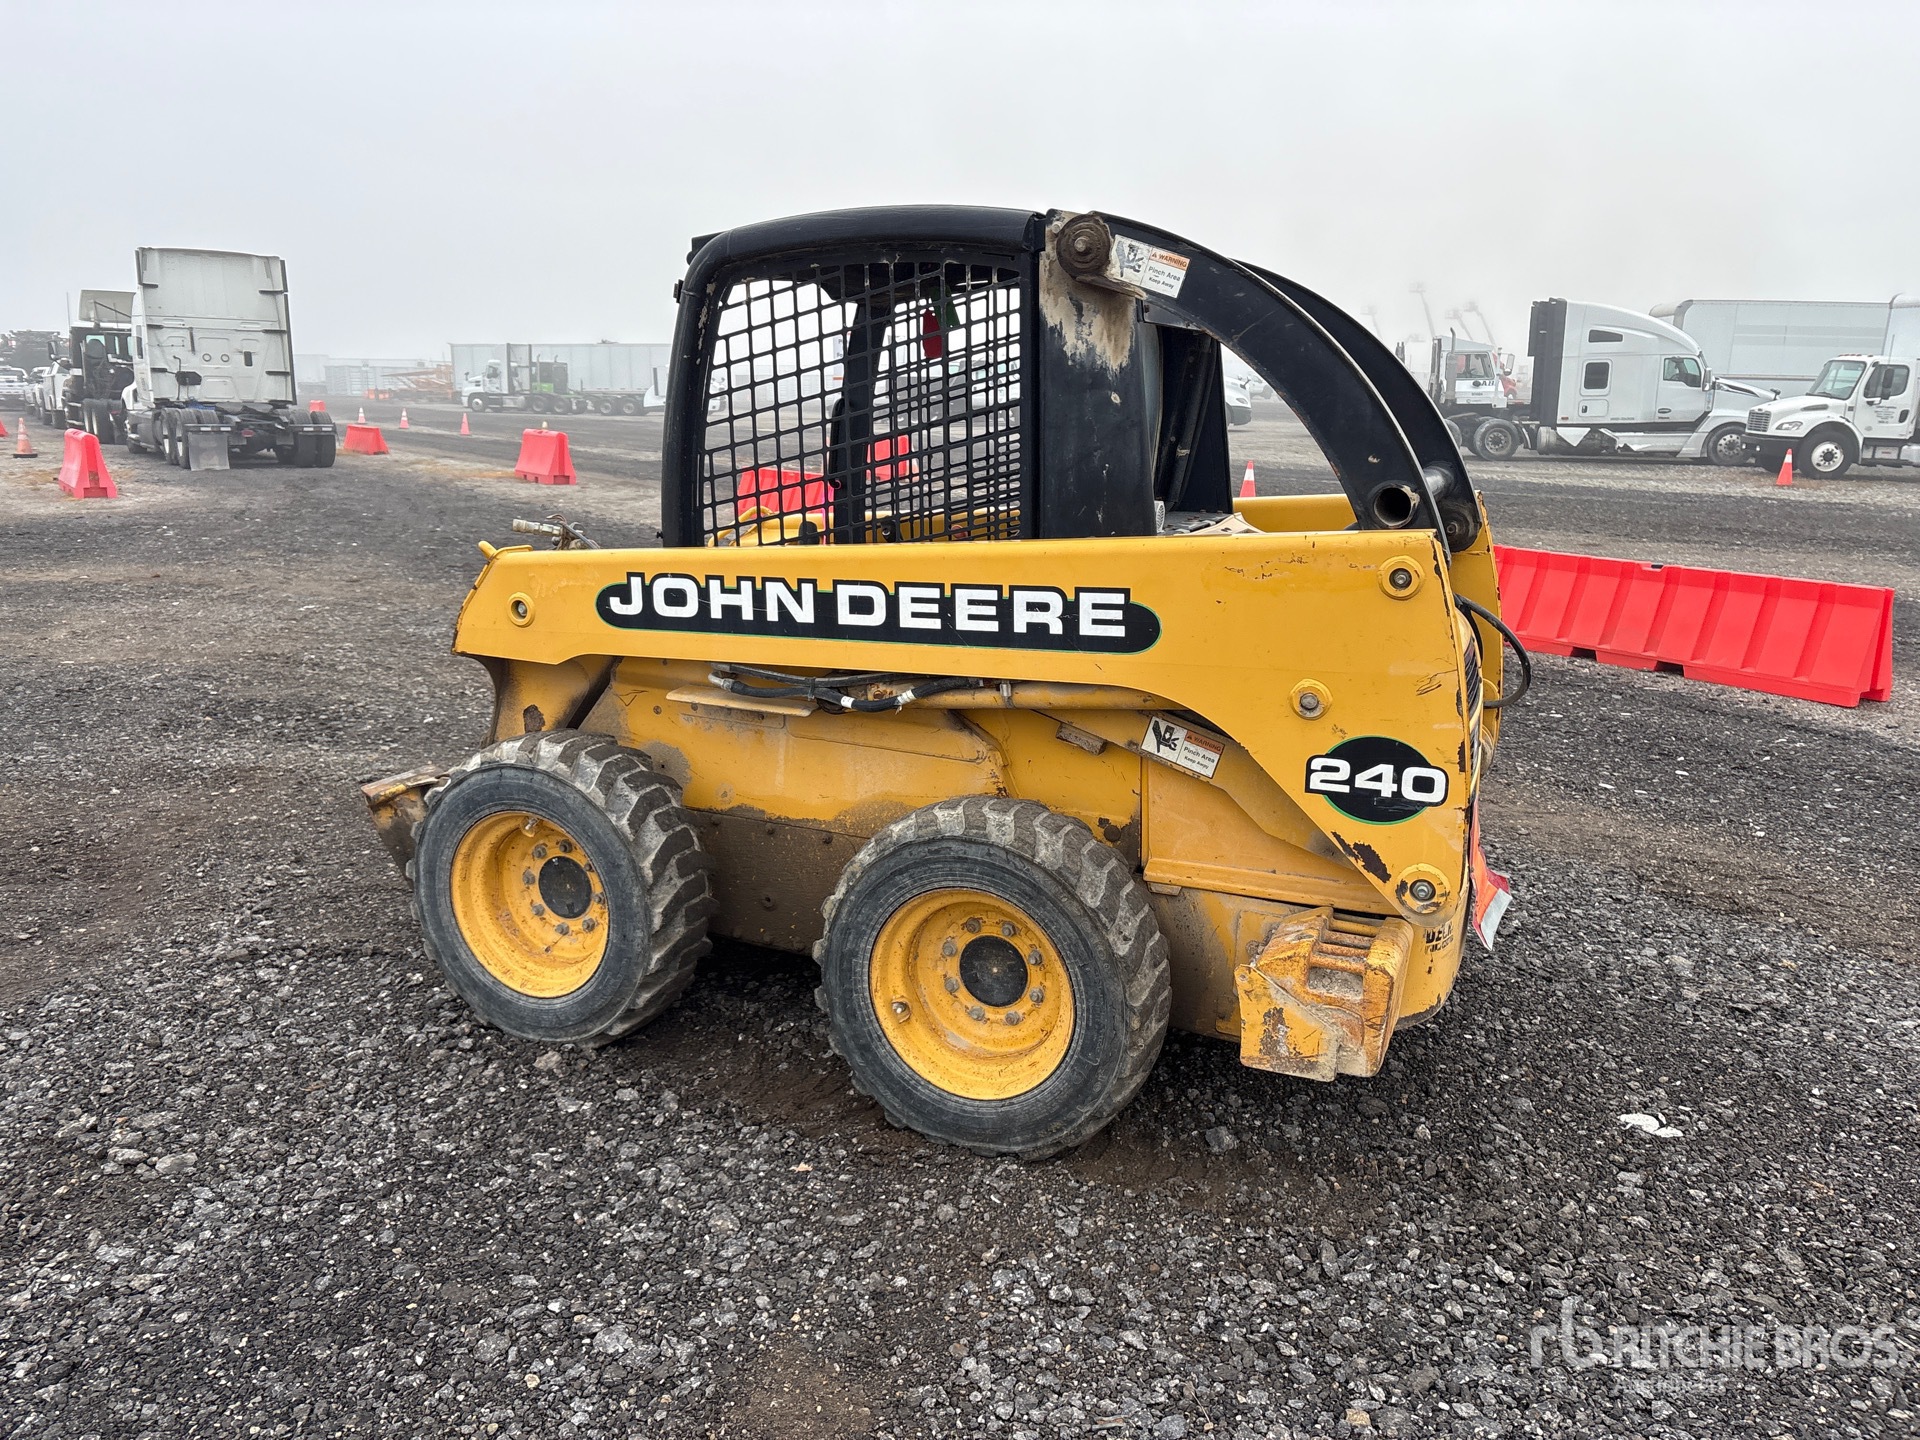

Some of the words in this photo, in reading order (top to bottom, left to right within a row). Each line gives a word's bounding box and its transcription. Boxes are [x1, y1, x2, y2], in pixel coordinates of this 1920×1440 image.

[1159, 253, 1187, 268] WARNING
[1148, 265, 1166, 277] Pinch
[1166, 272, 1181, 281] Area
[1149, 276, 1161, 286] Keep
[1161, 280, 1175, 289] Away
[609, 576, 815, 624] JOHN
[836, 584, 1126, 637] DEERE
[1194, 736, 1221, 751] WARNING
[1183, 746, 1201, 758] Pinch
[1201, 754, 1215, 764] Area
[1184, 755, 1196, 764] Keep
[1196, 761, 1209, 770] Away
[1309, 757, 1446, 803] 240
